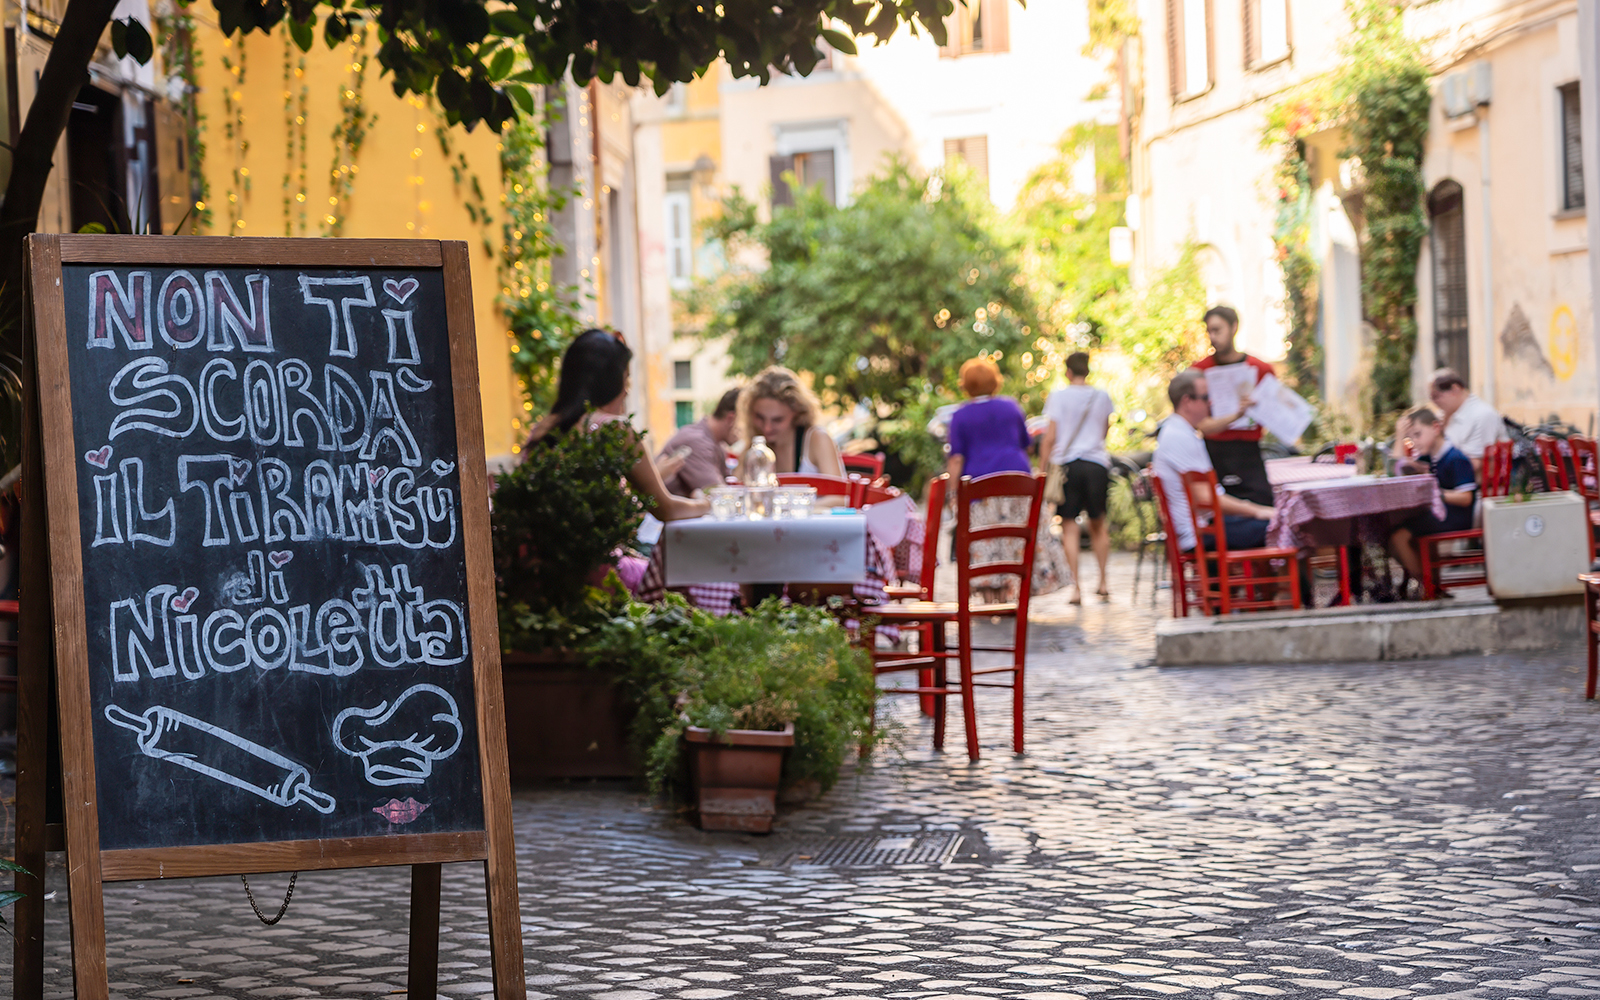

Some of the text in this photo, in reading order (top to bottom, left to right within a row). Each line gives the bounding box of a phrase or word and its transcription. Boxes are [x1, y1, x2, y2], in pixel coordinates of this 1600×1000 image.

[87, 270, 421, 365] NON Ti
[108, 356, 432, 467] SCORDÀ
[223, 549, 294, 603] di
